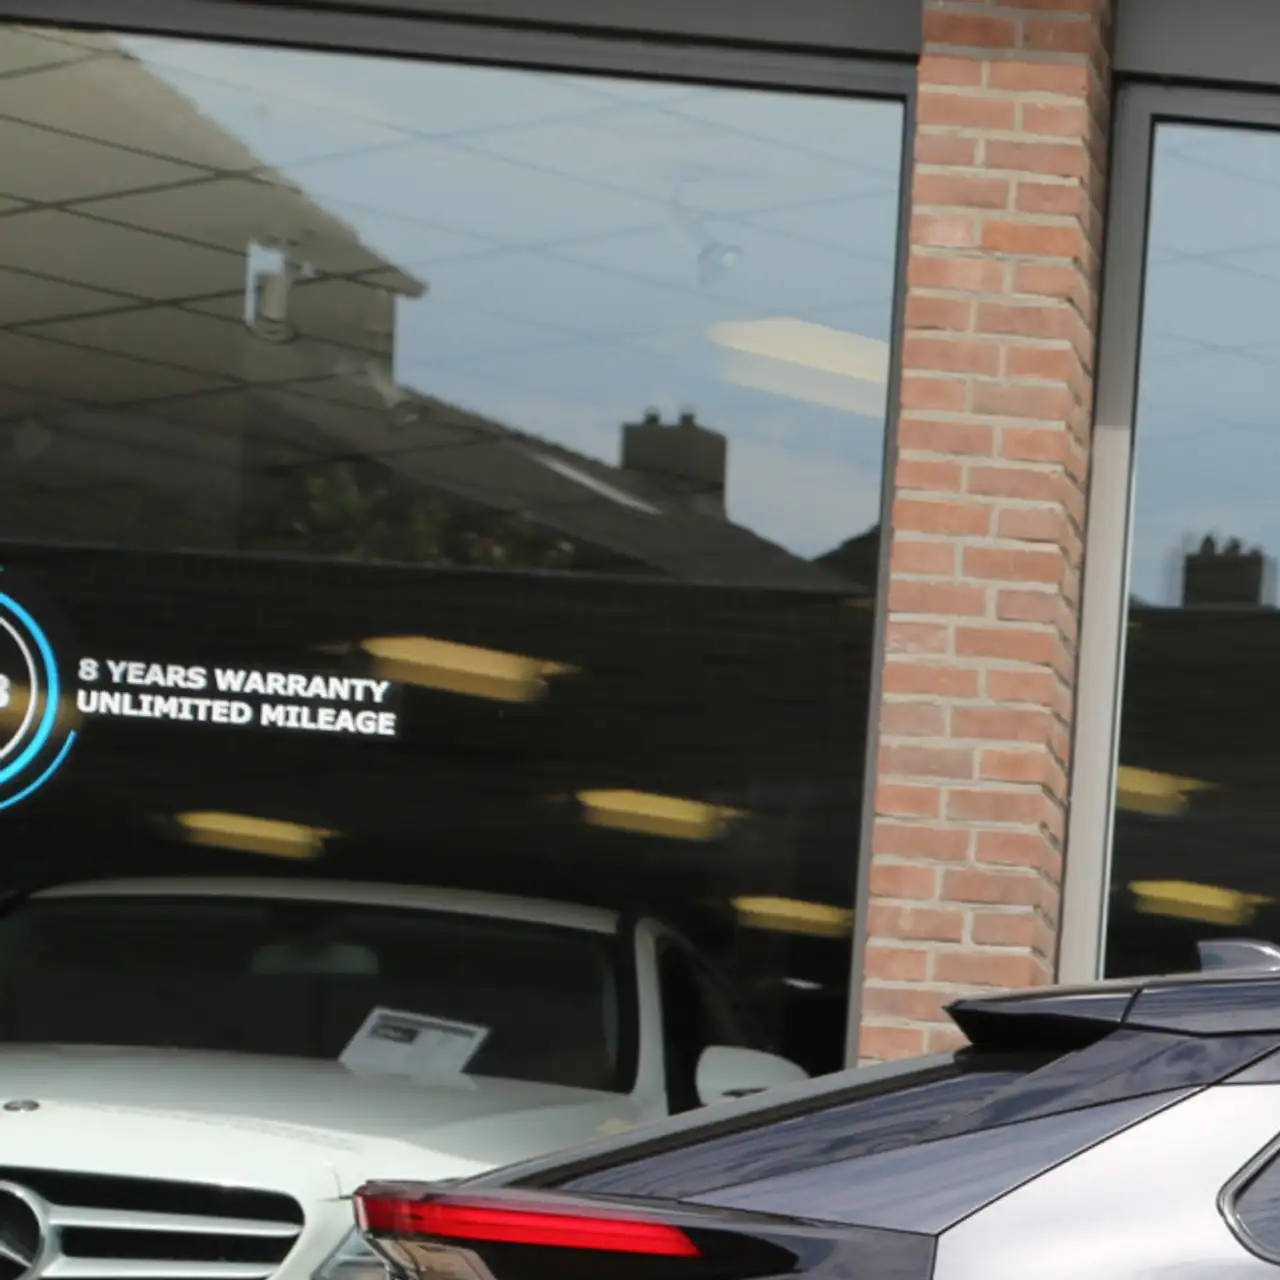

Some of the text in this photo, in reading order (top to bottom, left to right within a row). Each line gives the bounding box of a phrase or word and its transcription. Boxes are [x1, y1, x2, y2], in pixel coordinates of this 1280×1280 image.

[78, 658, 391, 703] 8 YEARS WARRANTY
[76, 690, 397, 735] UNLIMITED MILEAGE
